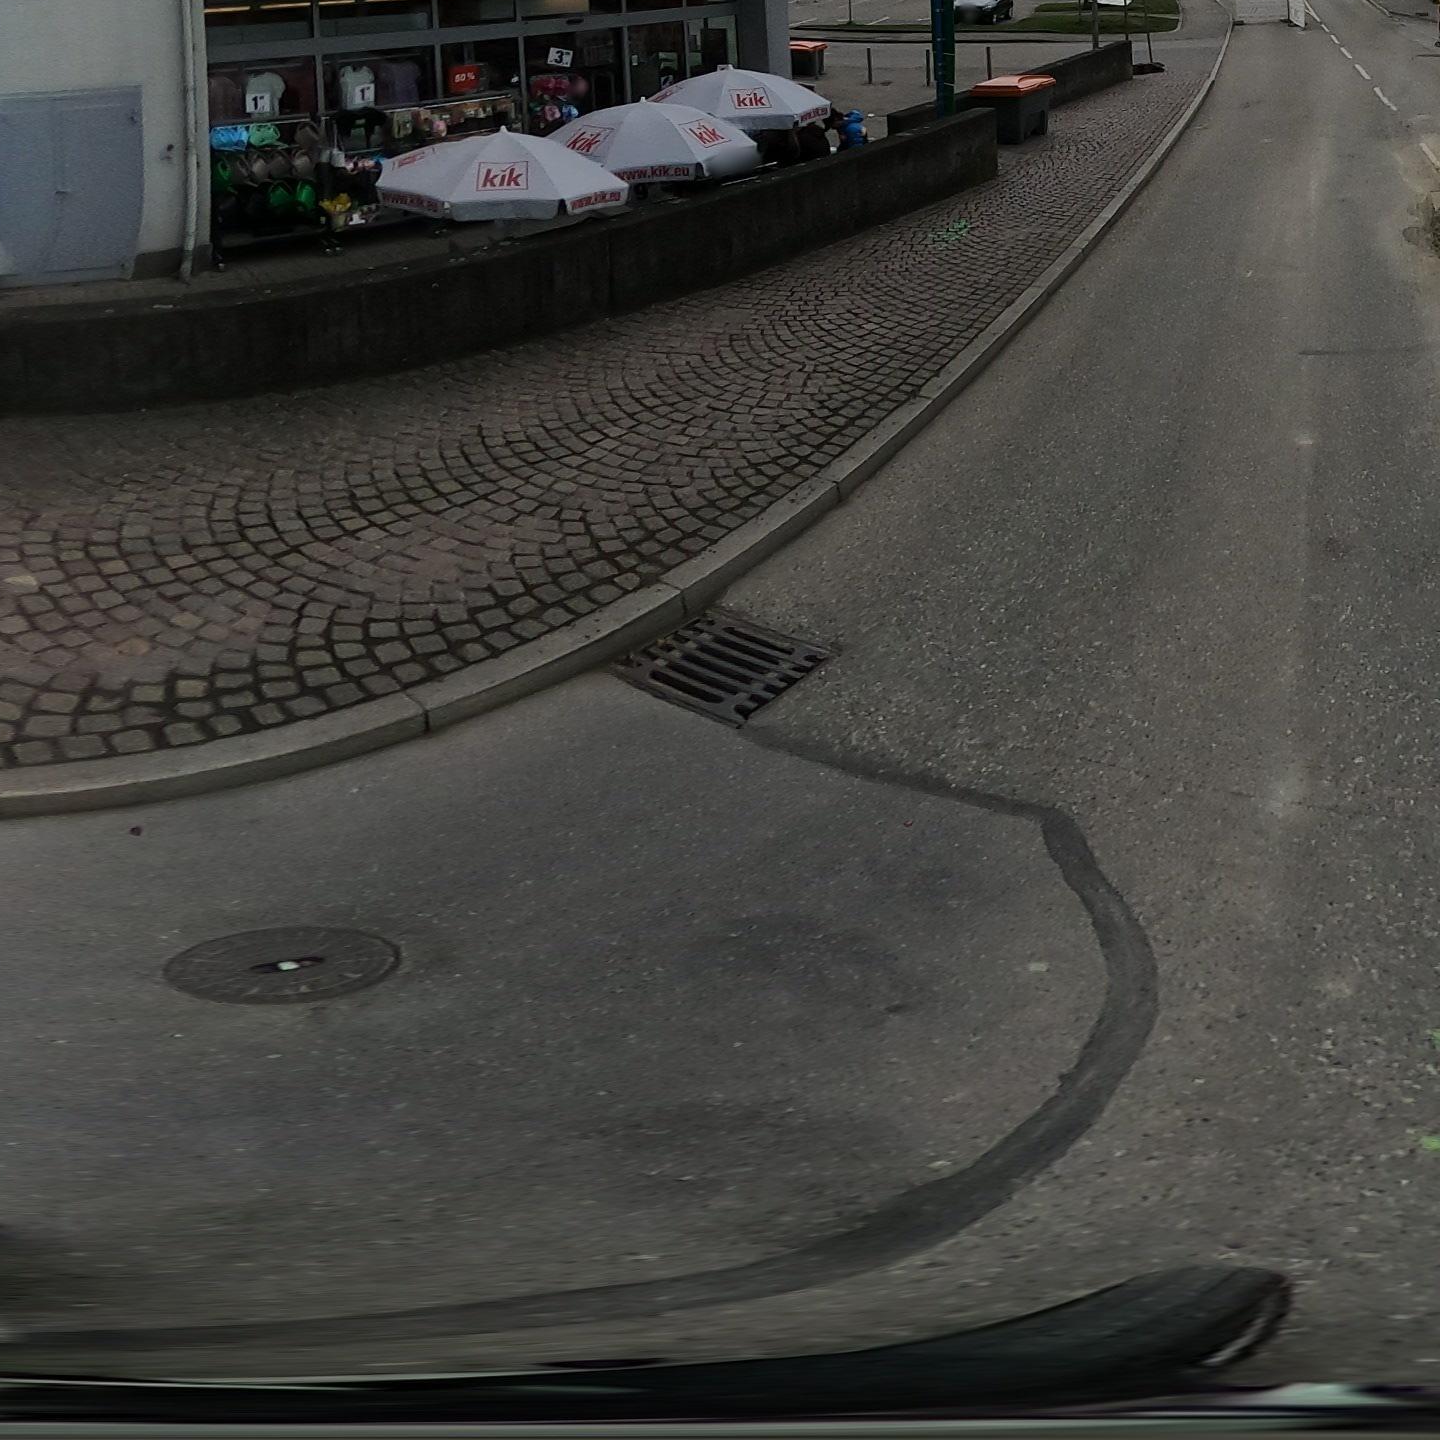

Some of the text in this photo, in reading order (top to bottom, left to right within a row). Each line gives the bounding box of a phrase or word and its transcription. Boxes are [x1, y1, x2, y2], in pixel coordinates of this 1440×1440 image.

[736, 90, 766, 108] kik
[567, 129, 601, 153] kik
[689, 120, 725, 146] kik
[481, 164, 524, 188] kik
